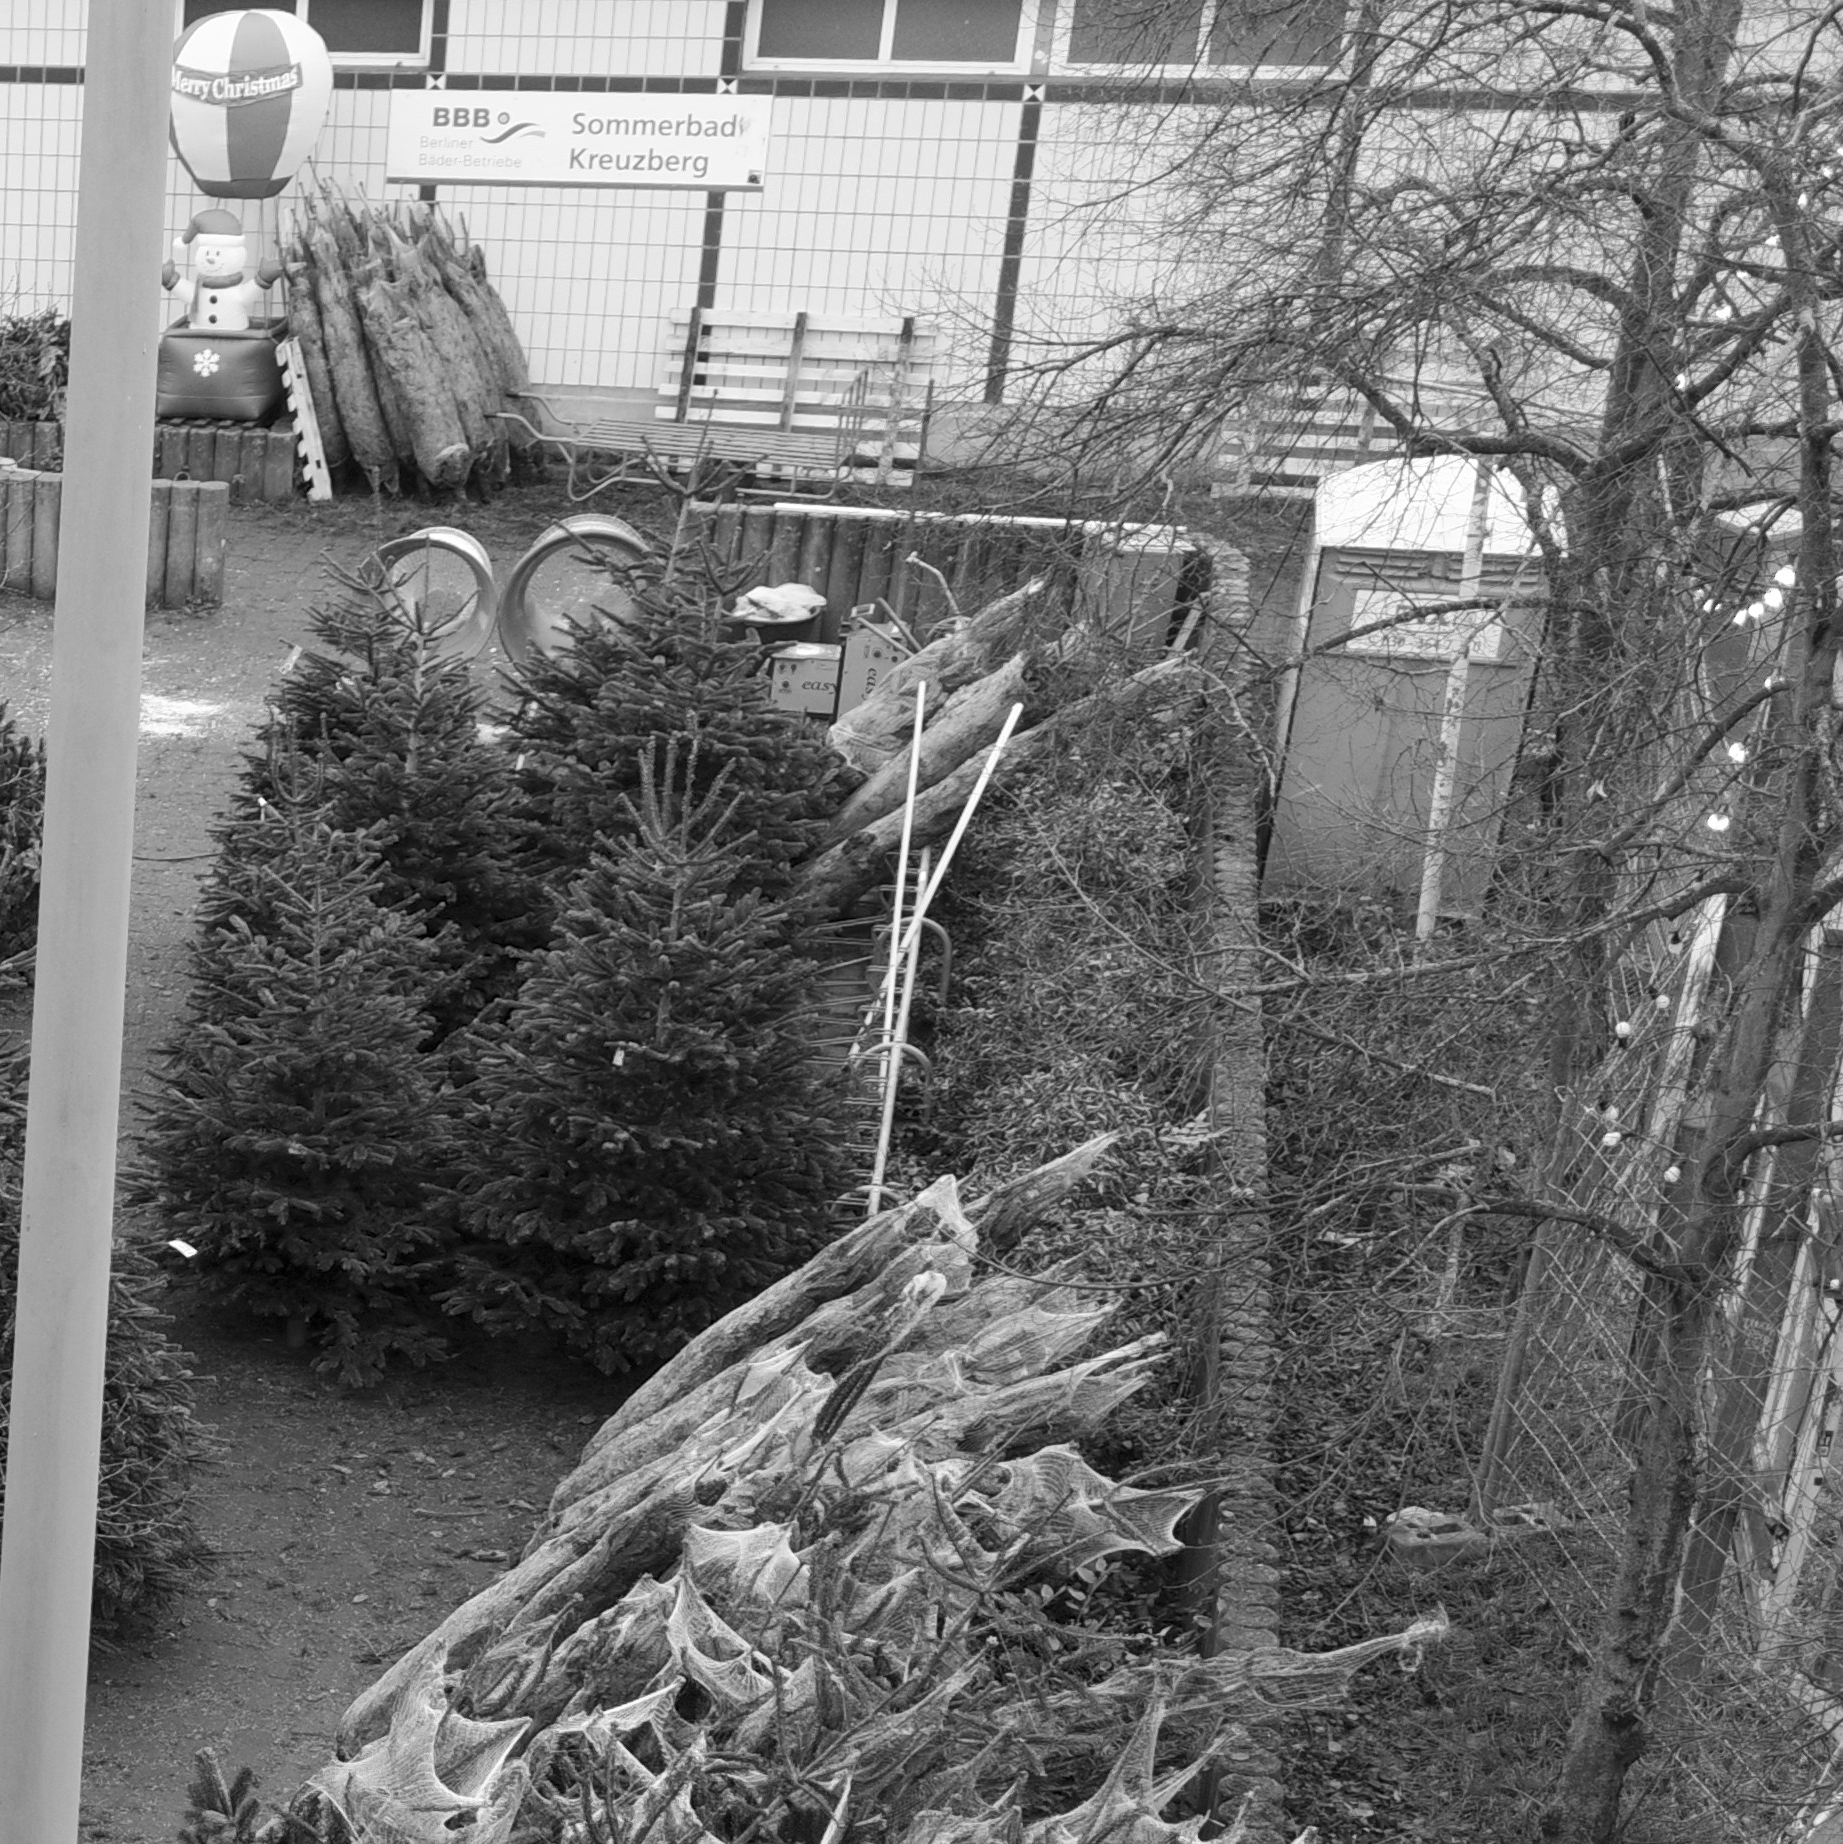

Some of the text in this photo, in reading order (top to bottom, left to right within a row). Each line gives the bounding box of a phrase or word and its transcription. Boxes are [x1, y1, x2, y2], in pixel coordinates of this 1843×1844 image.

[213, 70, 298, 99] Christmas
[433, 107, 490, 128] BBB
[572, 113, 737, 137] Sommerbad
[419, 136, 474, 150] Berliner
[569, 148, 709, 178] Kreuzberg
